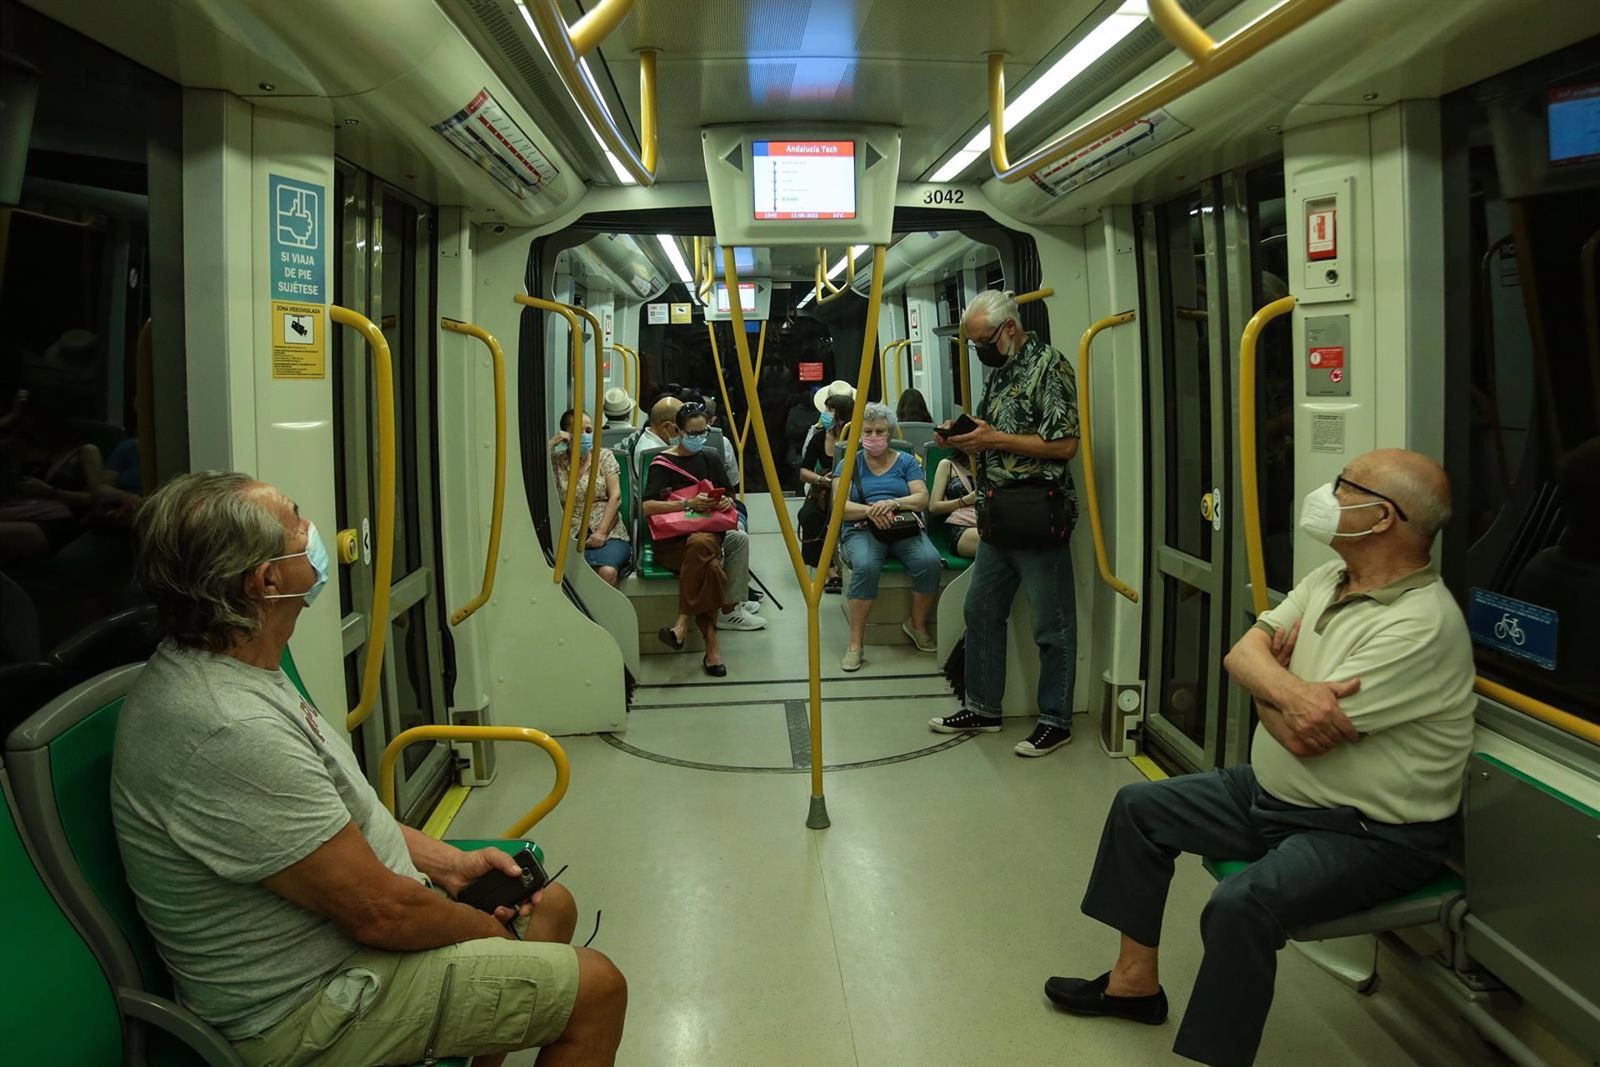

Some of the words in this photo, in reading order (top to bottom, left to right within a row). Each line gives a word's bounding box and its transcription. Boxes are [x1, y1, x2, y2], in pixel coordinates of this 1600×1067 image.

[821, 145, 838, 153] Tech
[923, 190, 965, 205] 3042
[280, 251, 290, 262] SI
[291, 253, 315, 266] VIAJA
[284, 266, 296, 278] DE
[298, 269, 312, 280] PIE
[278, 281, 318, 295] SUJÉTESE
[276, 304, 288, 312] ZONA
[289, 306, 320, 314] VIDEOVIGILADA
